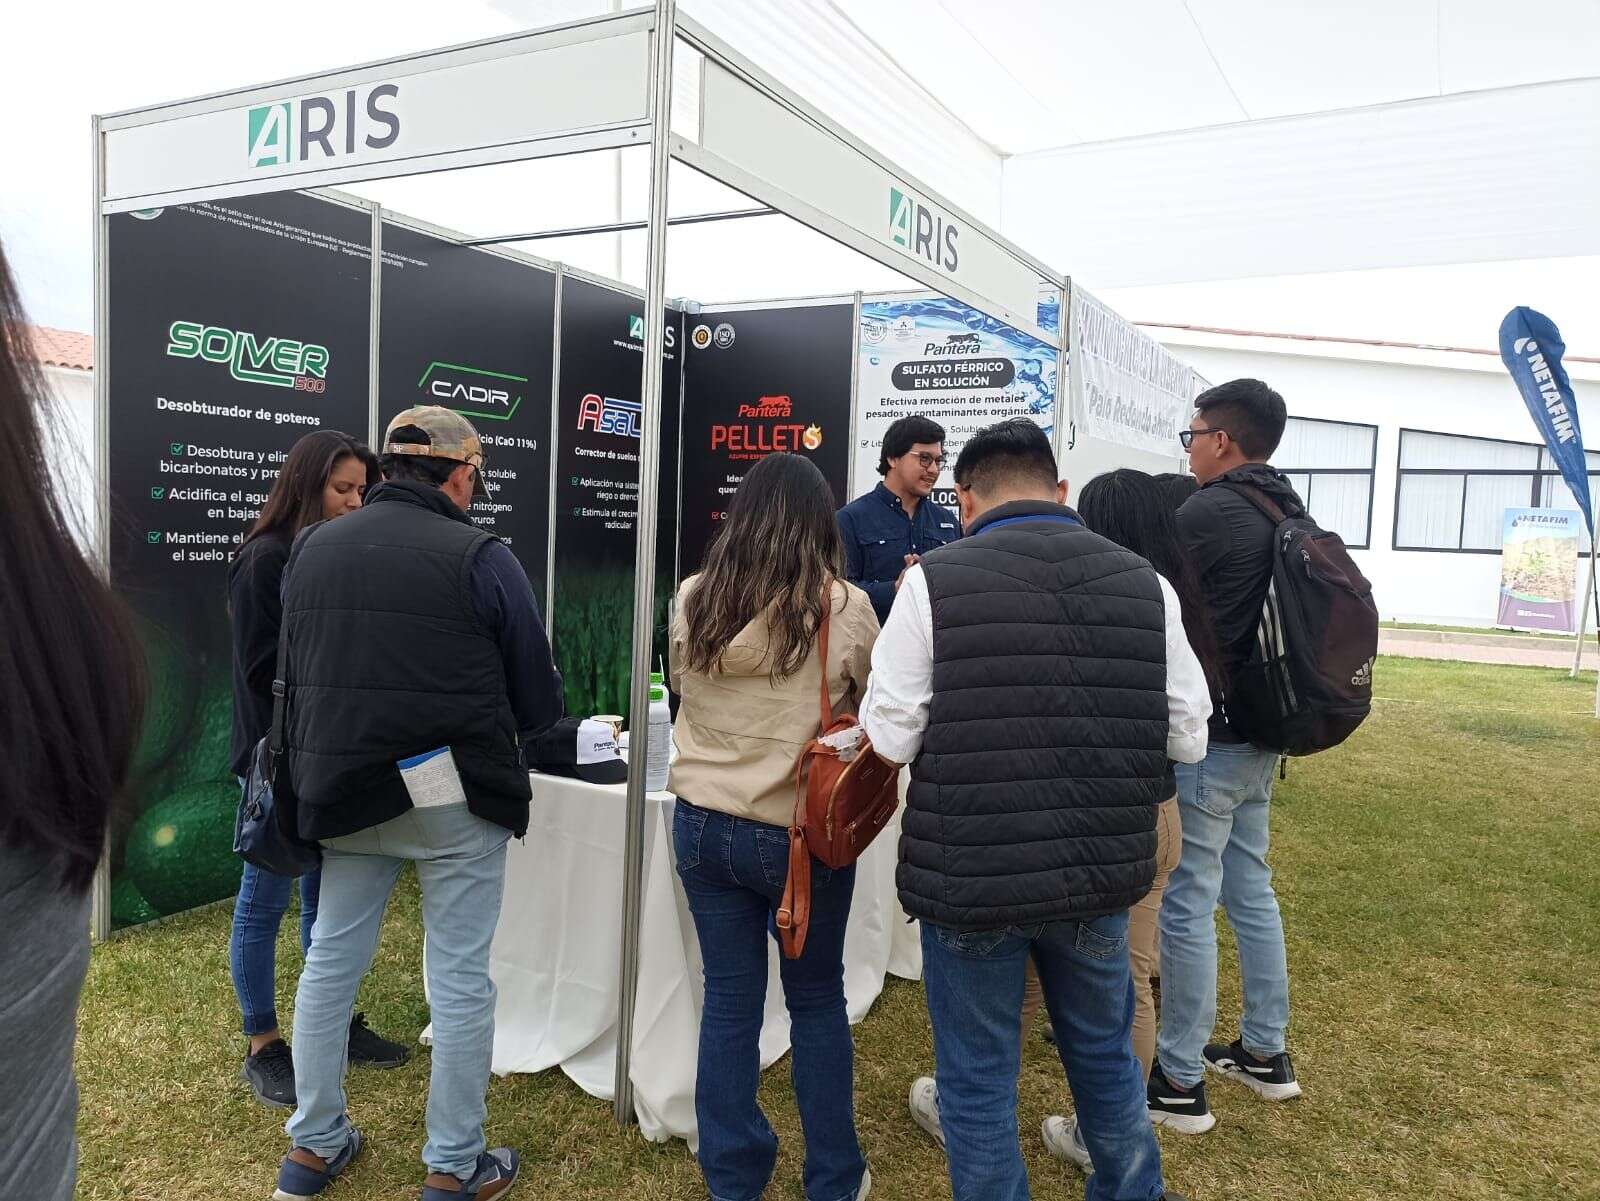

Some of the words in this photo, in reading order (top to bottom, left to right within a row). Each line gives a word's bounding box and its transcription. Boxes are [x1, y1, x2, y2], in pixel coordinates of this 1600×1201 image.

[249, 84, 400, 167] ARIS
[890, 187, 958, 272] ARIS
[167, 320, 330, 387] SOLVER
[924, 343, 980, 356] Pantera
[902, 364, 951, 375] SULFATO
[954, 361, 1004, 374] FÉRRICO
[295, 376, 325, 393] 500
[914, 378, 930, 388] EN
[932, 375, 990, 388] SOLUCIÓN
[431, 380, 509, 406] CADIR
[880, 397, 918, 406] Efectiva
[920, 396, 966, 406] remoción
[969, 395, 982, 404] de
[984, 394, 1026, 404] metales
[1527, 353, 1575, 444] NETAFIM
[156, 397, 252, 420] Desobturador
[255, 408, 272, 421] de
[275, 411, 321, 426] goteros
[738, 404, 791, 417] Pantera
[866, 409, 904, 419] pesados
[914, 408, 988, 417] contaminantes
[495, 435, 515, 447] (CaO
[711, 424, 822, 450] PELLETS
[187, 444, 255, 461] Desobtura
[257, 451, 266, 463] y
[267, 450, 289, 463] eli
[574, 446, 606, 458] Corrector
[607, 450, 616, 460] de
[617, 452, 637, 461] suelos
[160, 460, 248, 477] bicarbonatos
[250, 467, 258, 480] y
[261, 468, 281, 481] pre
[488, 469, 517, 479] soluble
[580, 477, 614, 488] Aplicación
[168, 487, 227, 502] Acidifica
[230, 489, 242, 502] el
[245, 492, 269, 505] agu
[596, 490, 613, 501] riego
[207, 508, 225, 518] en
[228, 506, 261, 521] bajas
[473, 501, 513, 513] nitrógeno
[581, 507, 610, 517] Estimula
[611, 509, 617, 517] el
[165, 531, 229, 545] Mantiene
[232, 531, 244, 544] el
[172, 549, 185, 562] el
[188, 549, 224, 562] suelo
